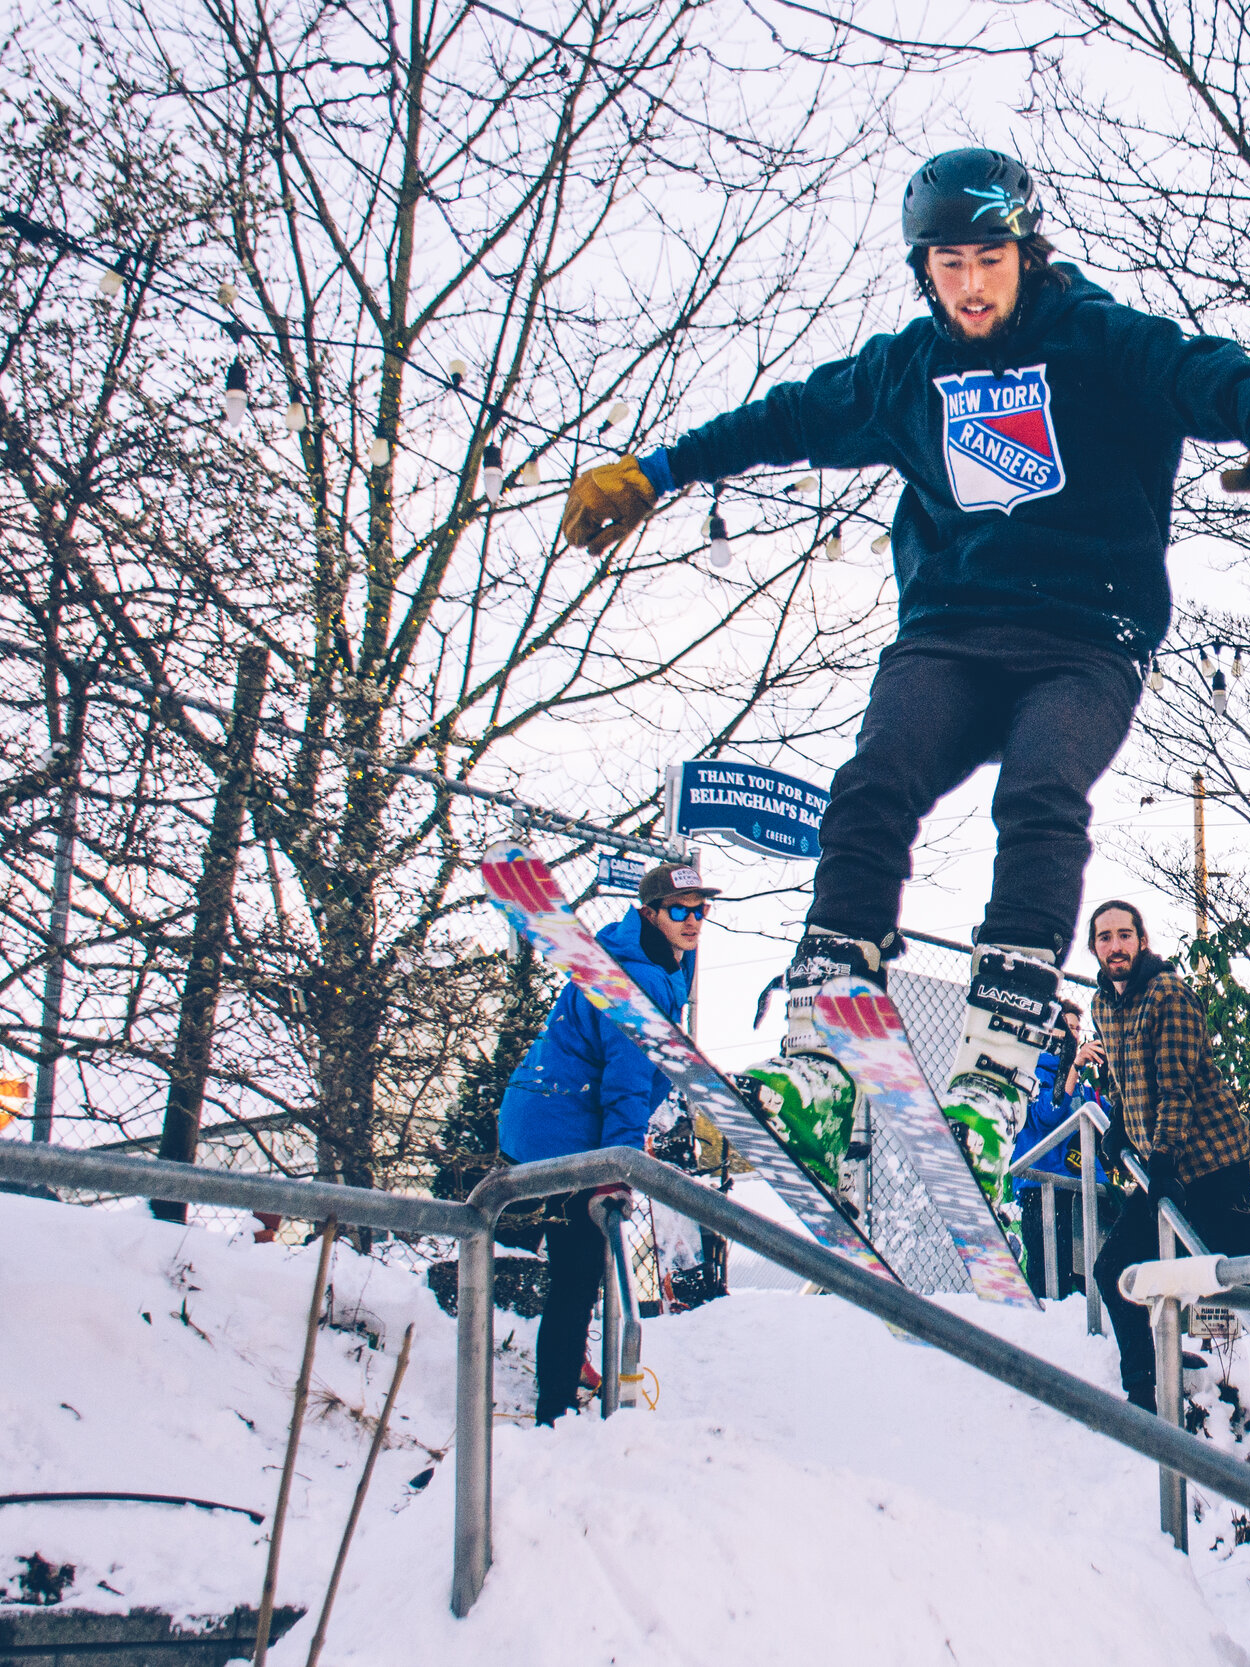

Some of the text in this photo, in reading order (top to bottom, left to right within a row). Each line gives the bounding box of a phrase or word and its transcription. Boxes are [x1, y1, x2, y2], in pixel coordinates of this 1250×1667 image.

[948, 383, 1041, 417] NEW YORK
[960, 422, 1051, 485] RANGERS
[698, 769, 745, 786] THANK
[747, 774, 774, 792] YOU
[777, 781, 802, 802] FOR
[690, 788, 797, 820] BELLINGHAM'S
[765, 829, 796, 846] CHEERS!
[977, 984, 1043, 1015] LANGE
